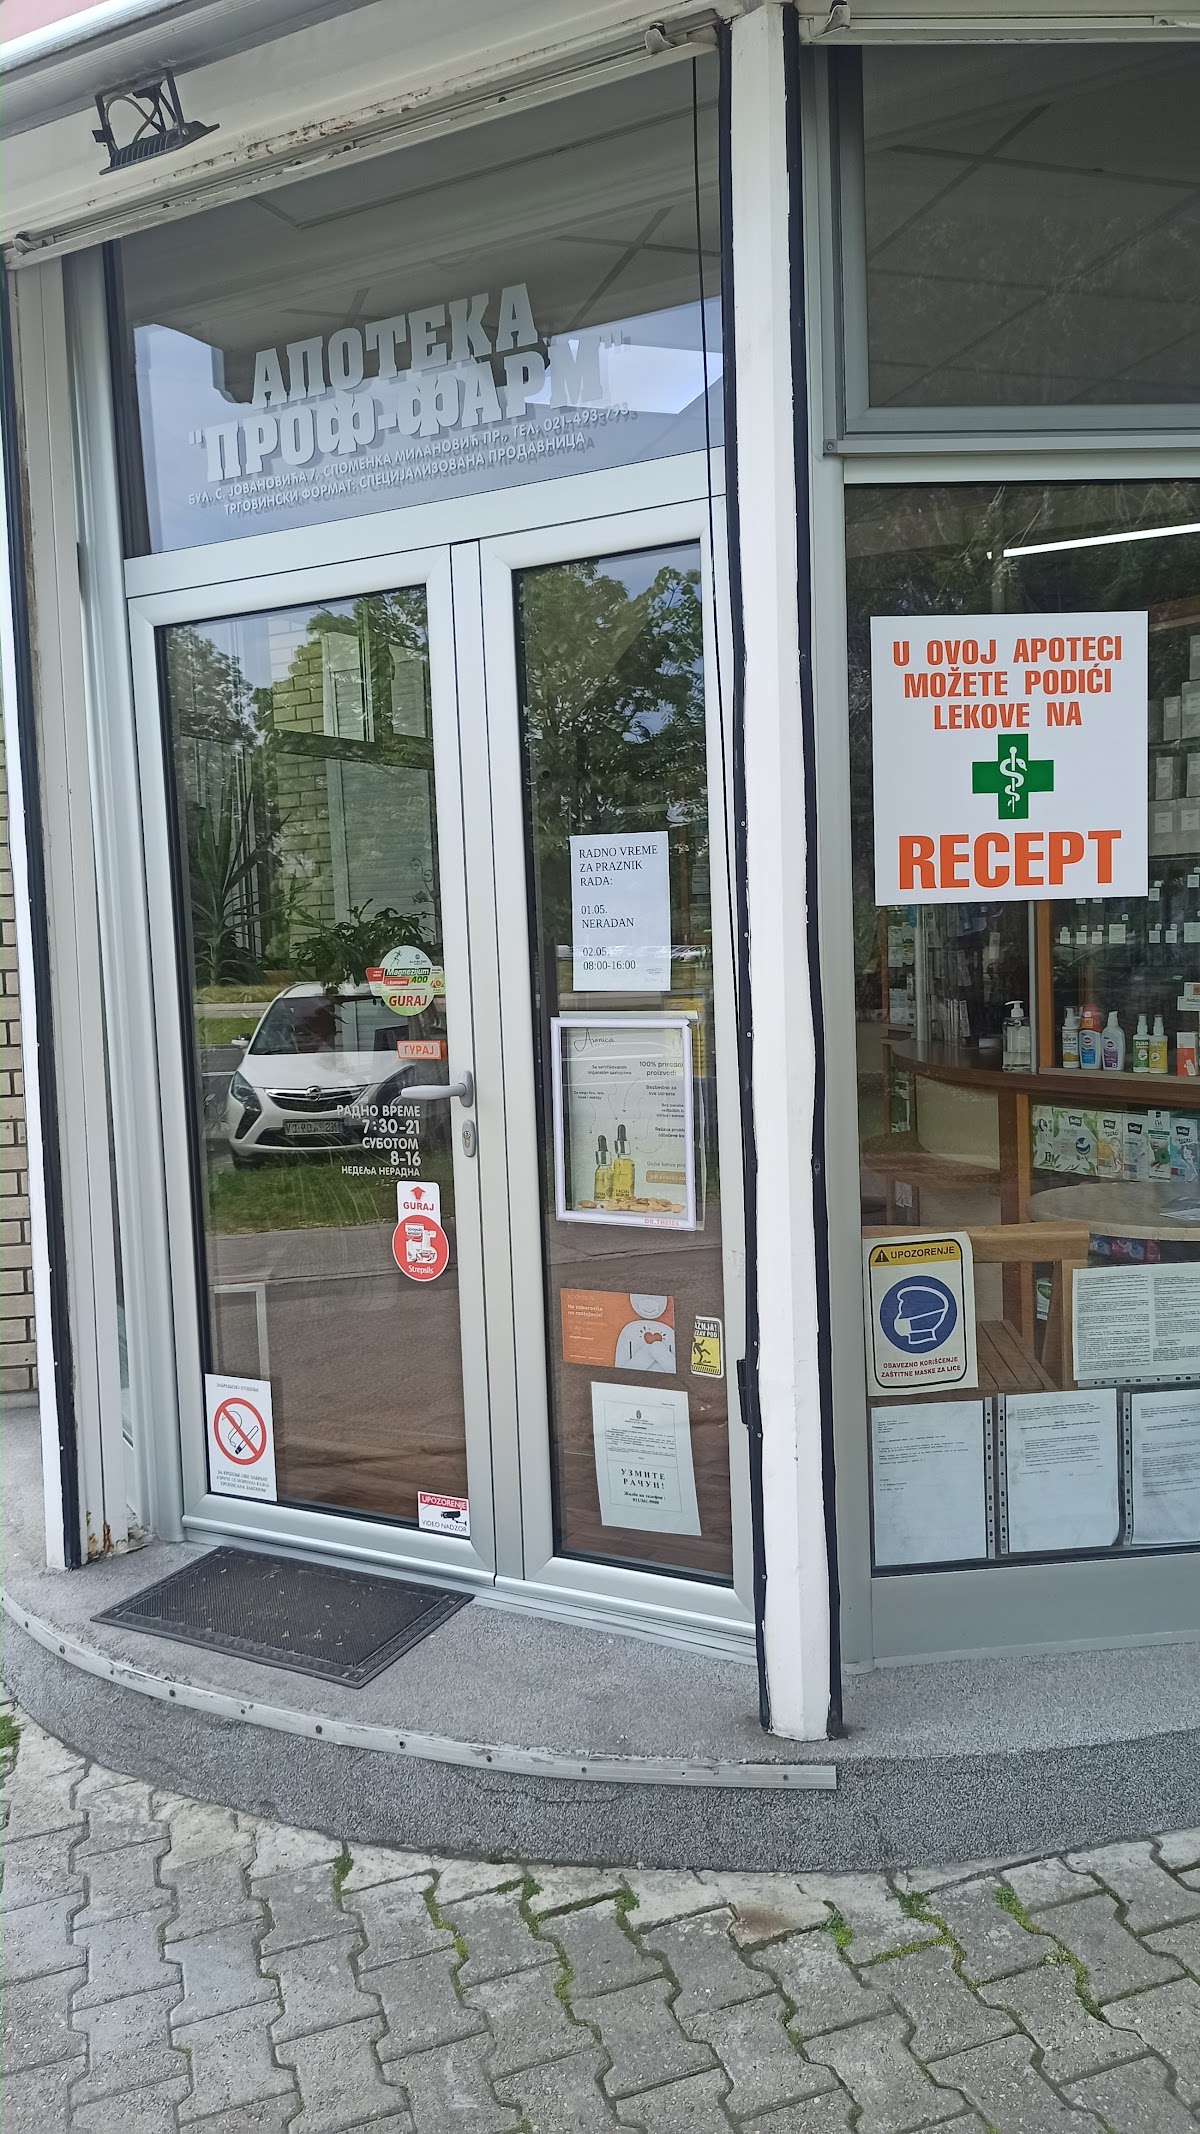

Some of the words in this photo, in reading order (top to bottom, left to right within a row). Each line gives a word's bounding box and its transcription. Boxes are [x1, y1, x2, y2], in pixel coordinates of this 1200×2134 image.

[252, 283, 538, 410] АПОТЕКА
[188, 493, 212, 505] БУЛ.
[215, 488, 225, 500] С.
[228, 472, 307, 497] ЈОВАНОВИЋА
[323, 453, 391, 477] СПОМЕНКА
[396, 435, 479, 463] МИЛАНОВИЋ
[224, 490, 299, 515] ТРГОВИНСКИ
[359, 456, 485, 489] СПЕЦИЈАЛИЗОВАНА
[488, 431, 585, 466] ПРОДАВНИЦА
[893, 641, 909, 666] U
[926, 639, 997, 666] OVOJ
[1013, 635, 1122, 663] APOTECI
[904, 666, 1008, 698] MOŽETE
[1024, 663, 1112, 695] PODIĆI
[933, 702, 1030, 730] LEKOVE
[1046, 701, 1083, 727] NA
[579, 847, 617, 858] RADNO
[620, 844, 658, 856] VREME
[898, 829, 1122, 890] RECEPT
[579, 862, 593, 873] ZA
[596, 860, 643, 872] PRAZNIK
[580, 876, 613, 886] RADA:
[581, 904, 608, 915] 01.05.
[582, 917, 634, 928] NERADAN
[582, 947, 610, 956] 02.05.
[583, 960, 636, 971] 08:00-16:00
[410, 976, 428, 984] 400
[389, 995, 428, 1007] GURAJ
[404, 1045, 434, 1055] ГУРАЈ
[336, 1105, 379, 1119] РАДНО
[382, 1105, 421, 1117] ВРЕМЕ
[362, 1118, 420, 1135] 7:30-21
[362, 1136, 419, 1150] СУБОТОМ
[390, 1150, 422, 1167] 8-16
[341, 1165, 377, 1176] НЕДЕЉА
[379, 1166, 421, 1178] НЕРАДНА
[403, 1201, 435, 1211] GURAJ
[890, 1246, 955, 1259] UPOZORENJE
[408, 1264, 434, 1275] Strepsils
[883, 1361, 918, 1369] OBAVEZNO
[915, 1368, 936, 1376] MASKE
[620, 1468, 666, 1480] УЗМИТЕ
[421, 1495, 467, 1510] UPOZORENJE
[421, 1520, 440, 1528] VIDEO
[441, 1523, 467, 1532] NADZOR
